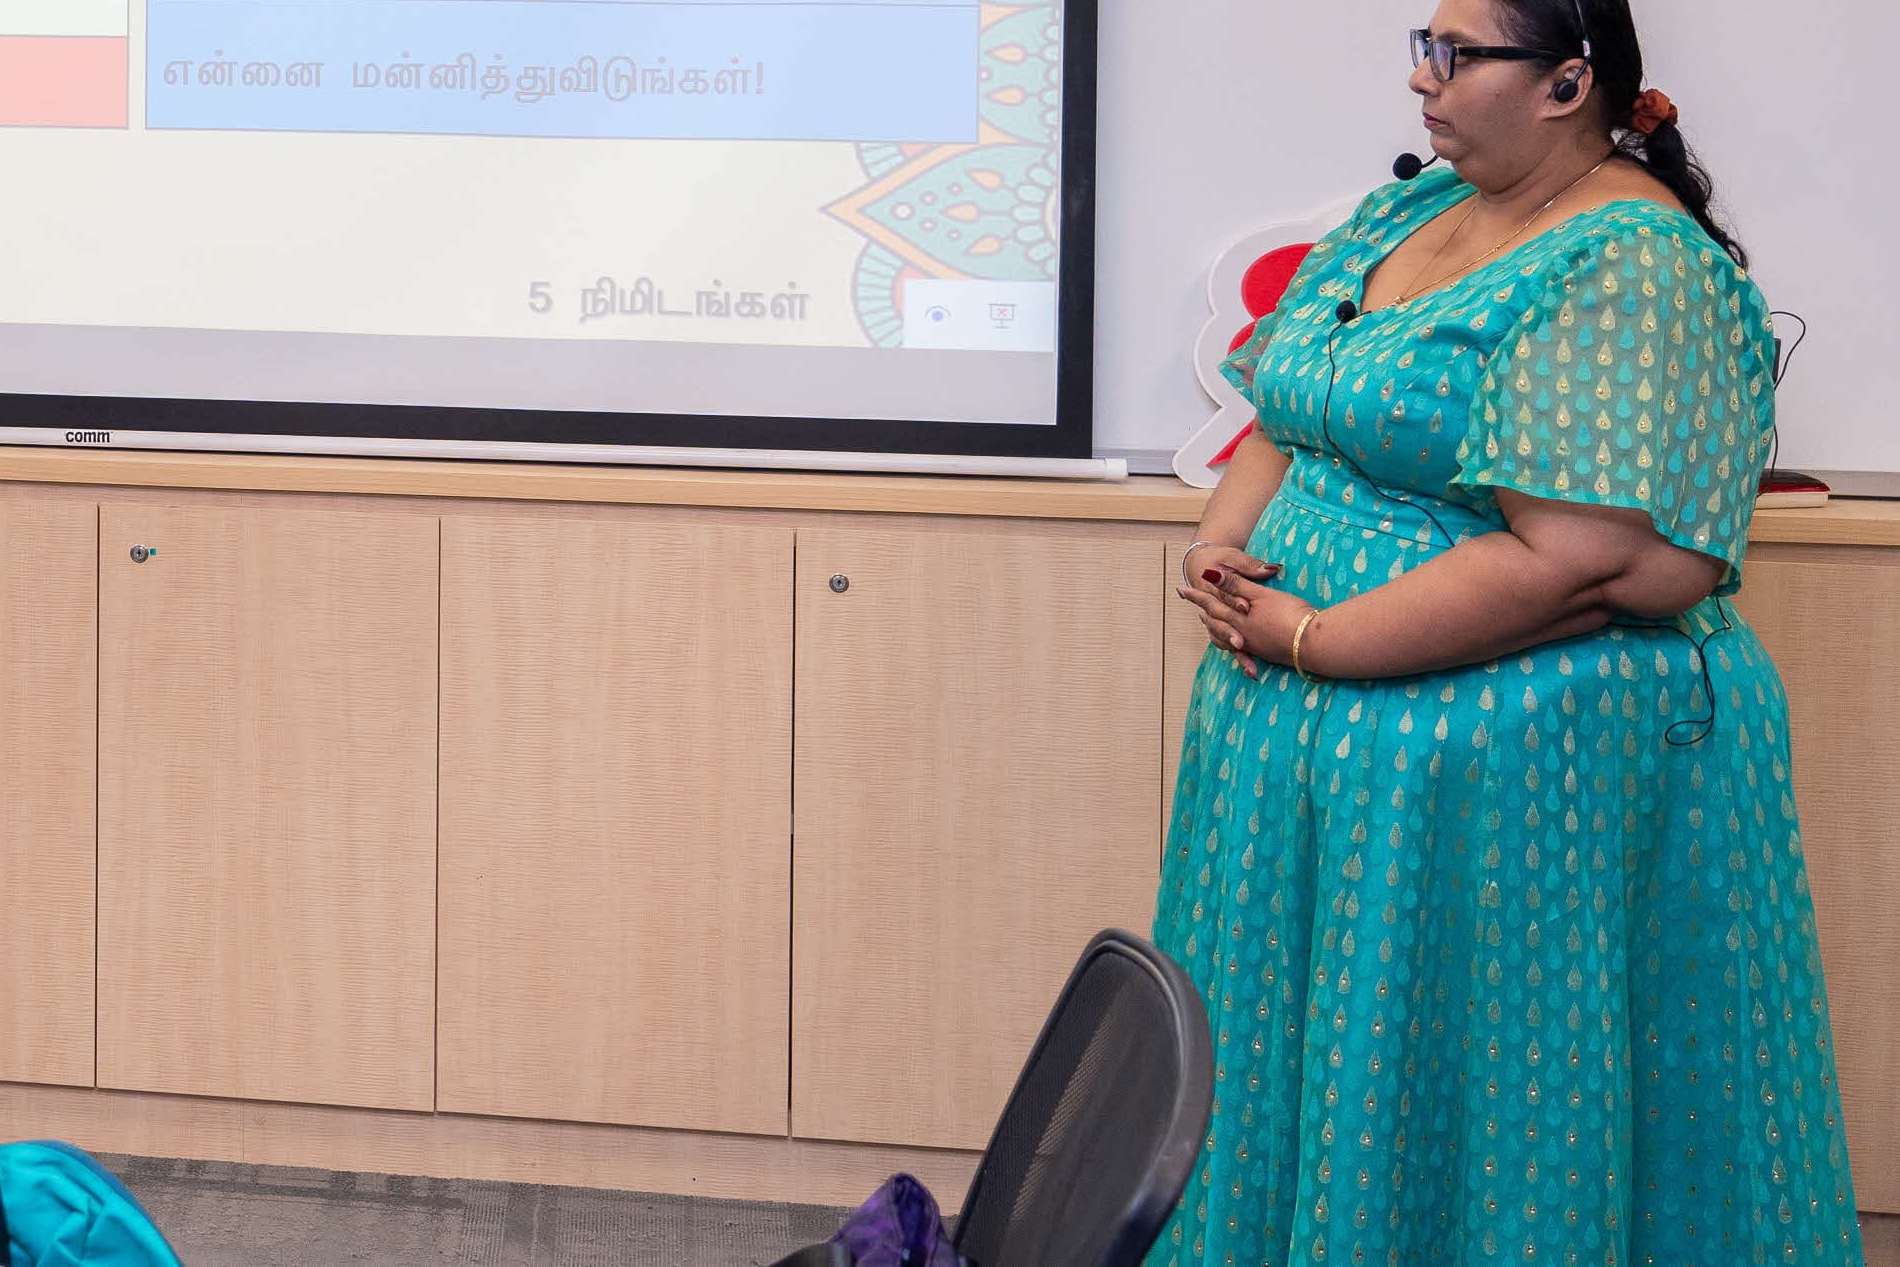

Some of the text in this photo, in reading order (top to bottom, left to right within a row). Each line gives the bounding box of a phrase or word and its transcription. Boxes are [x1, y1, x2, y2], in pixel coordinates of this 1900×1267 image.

[164, 50, 763, 104] என்னை மன்னித்துவிடுங்கள்!
[529, 276, 809, 323] 5 நிமிடங்கள்
[65, 431, 111, 443] comm
